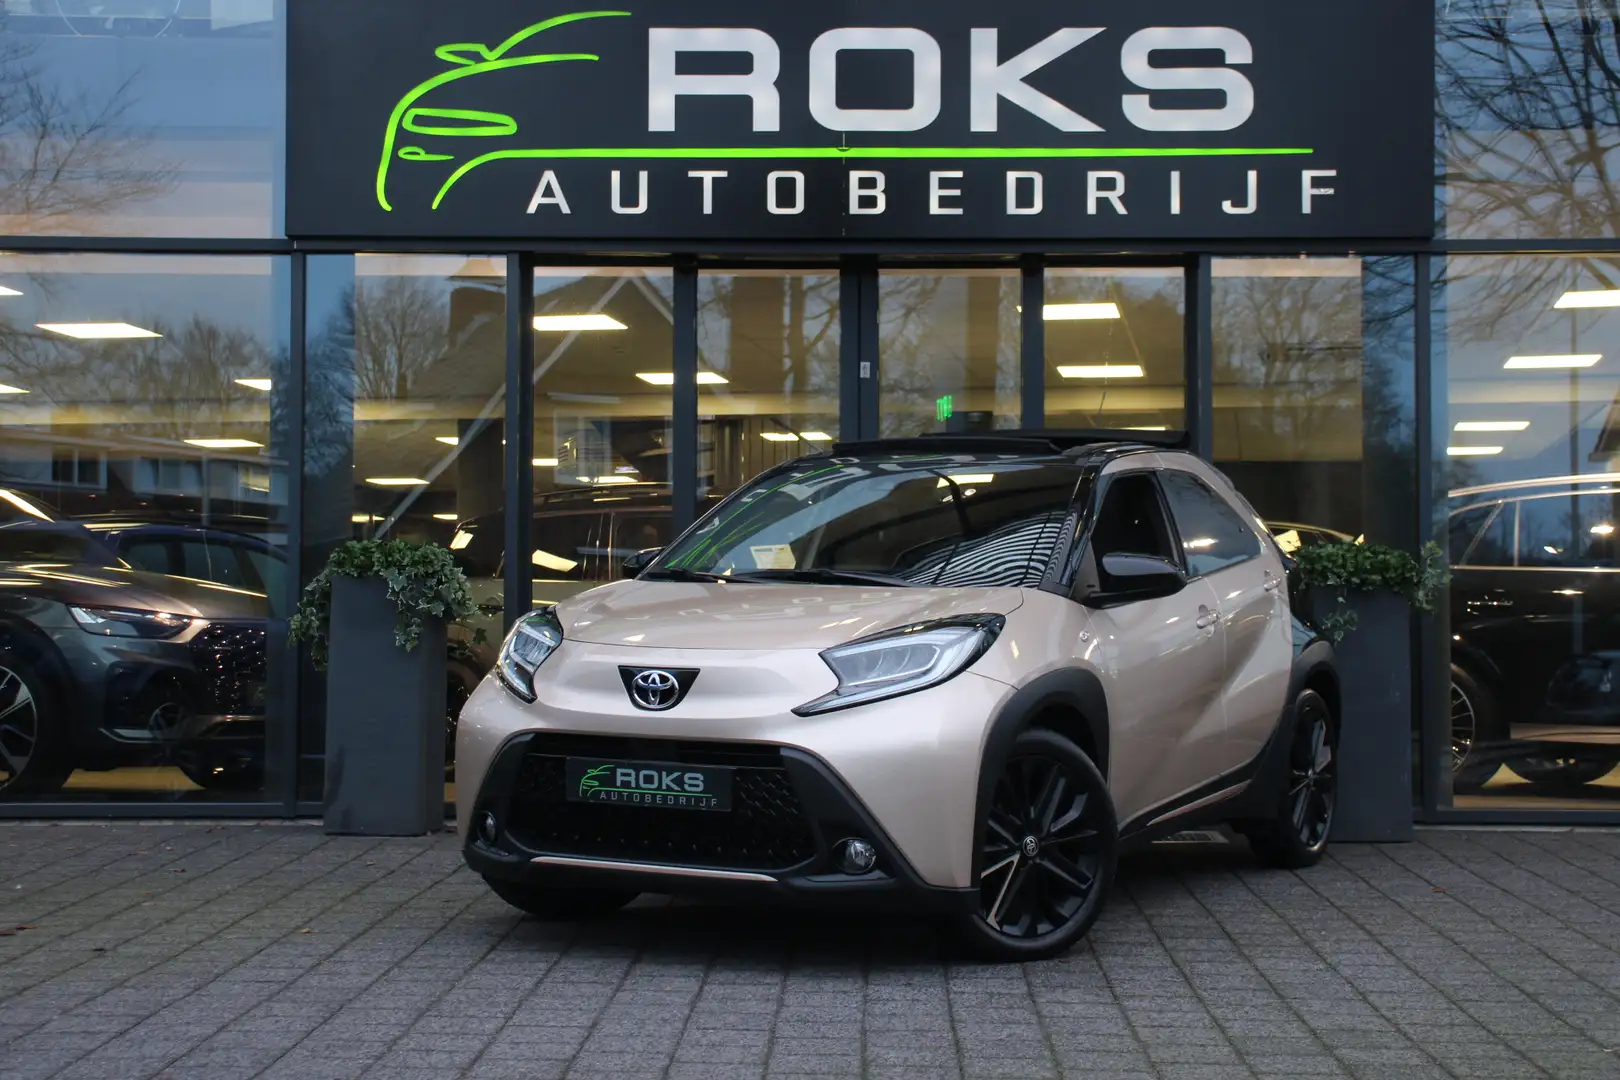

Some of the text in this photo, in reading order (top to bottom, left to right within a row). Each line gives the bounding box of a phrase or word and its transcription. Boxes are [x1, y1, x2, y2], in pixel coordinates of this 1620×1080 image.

[647, 26, 1255, 133] ROKS
[526, 169, 1337, 216] AUTOBEDRIJF
[616, 768, 704, 792] ROKS
[600, 791, 717, 807] AUTOBEDRIJF
